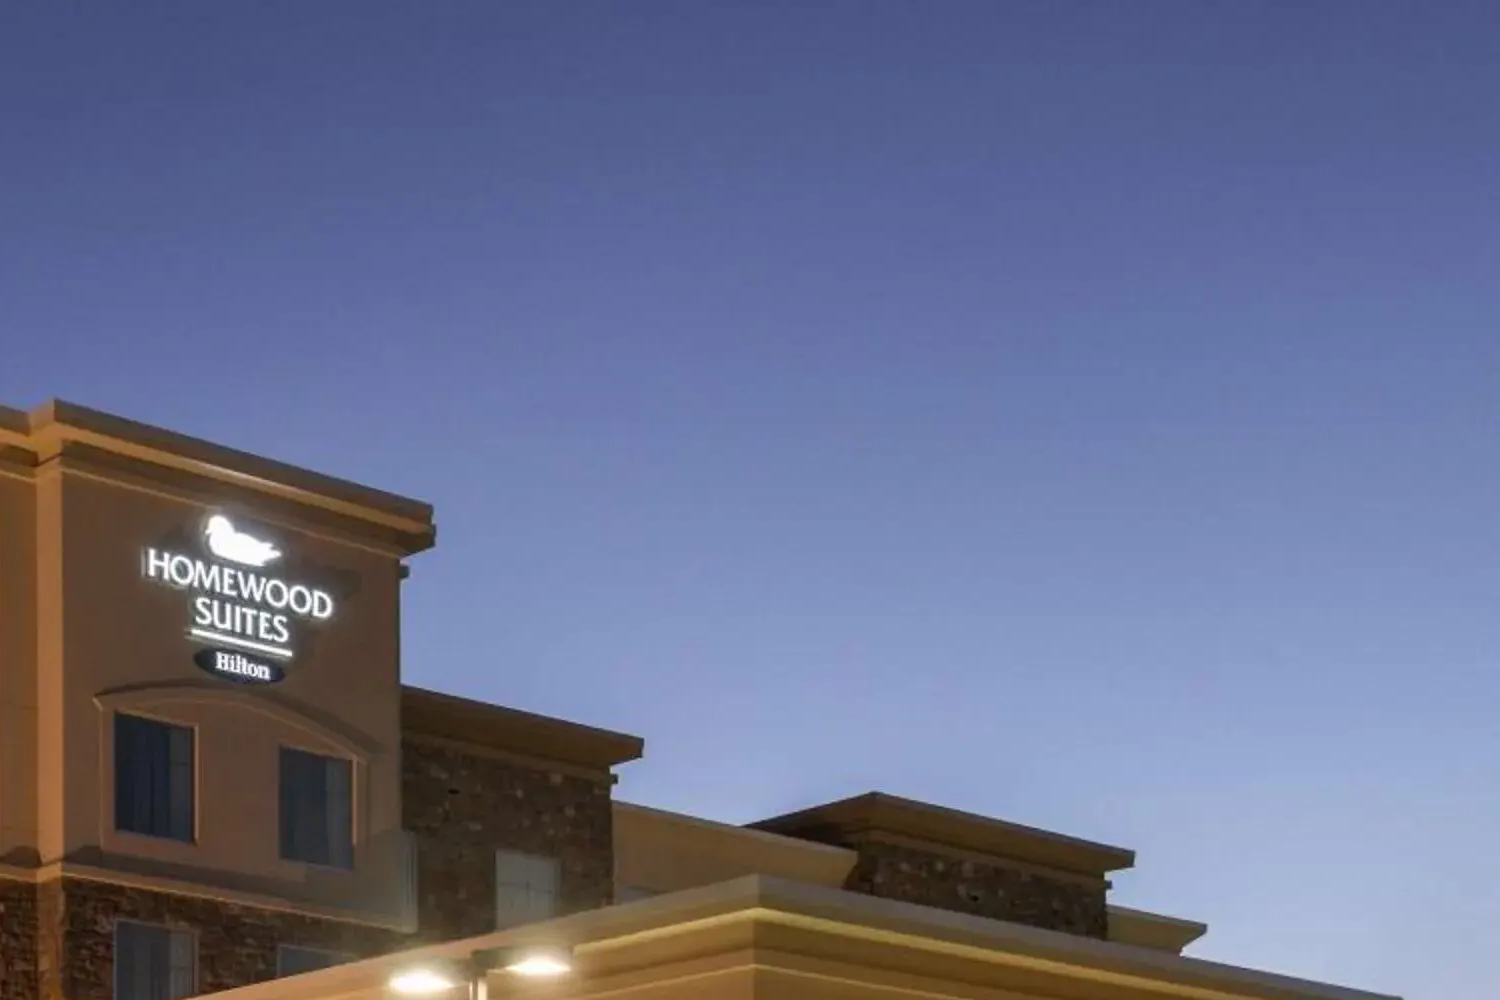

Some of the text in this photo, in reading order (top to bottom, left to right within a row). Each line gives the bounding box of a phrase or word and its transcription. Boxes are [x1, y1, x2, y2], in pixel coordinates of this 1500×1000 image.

[147, 548, 333, 619] HOMEWOOD
[194, 597, 290, 643] SUITES
[215, 651, 271, 681] Hilton
